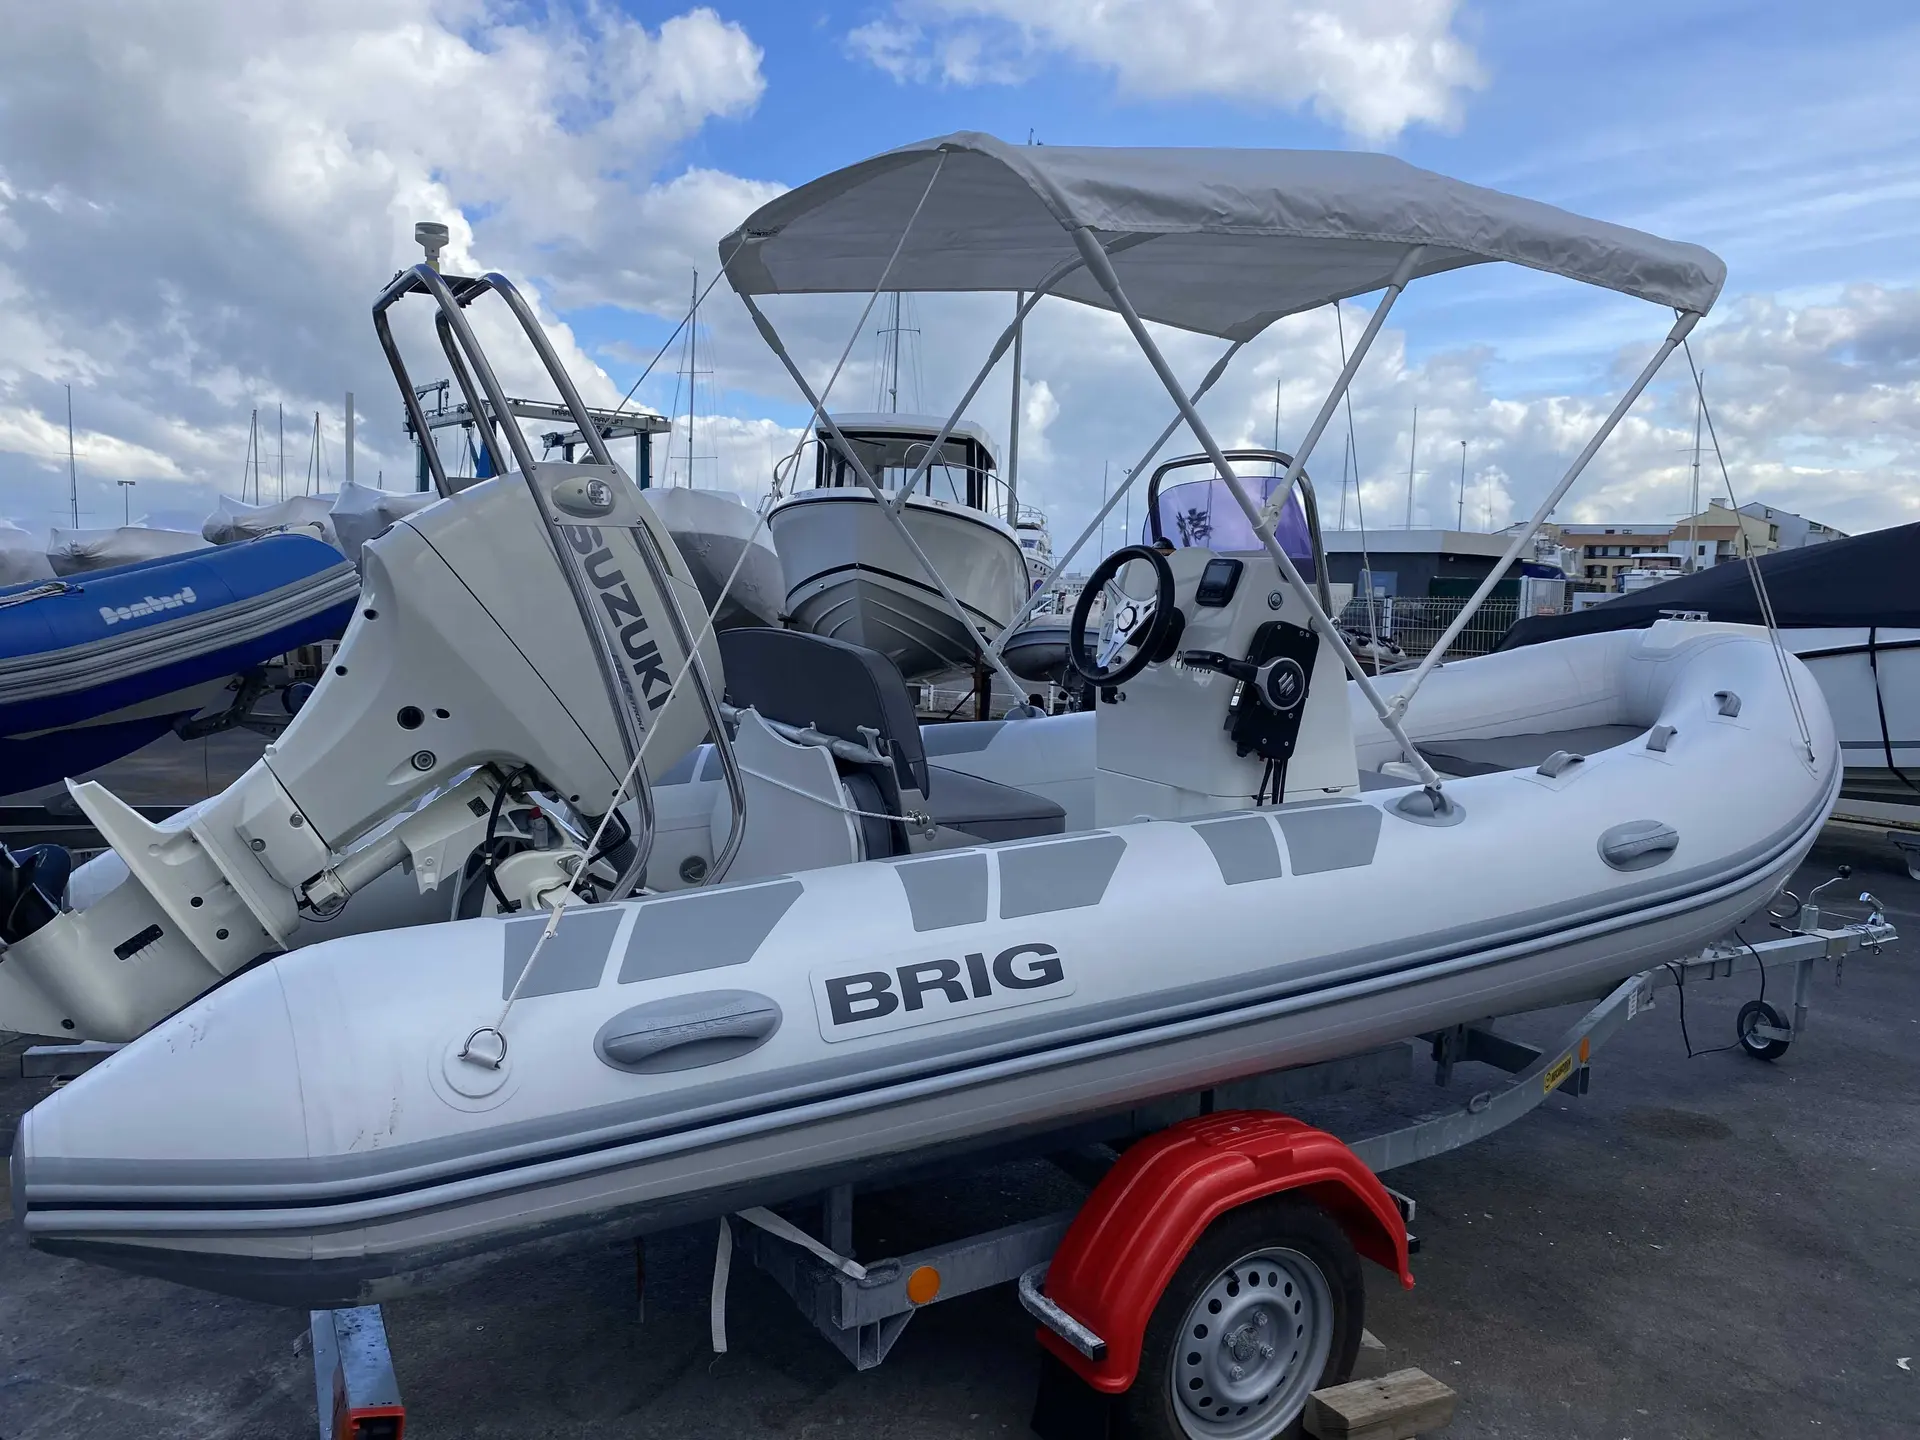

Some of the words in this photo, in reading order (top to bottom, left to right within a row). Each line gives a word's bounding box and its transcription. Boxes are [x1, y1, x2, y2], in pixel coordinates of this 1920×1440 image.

[98, 586, 197, 625] Bombard
[564, 525, 676, 712] SUZUKI
[824, 942, 1065, 1026] BRIG
